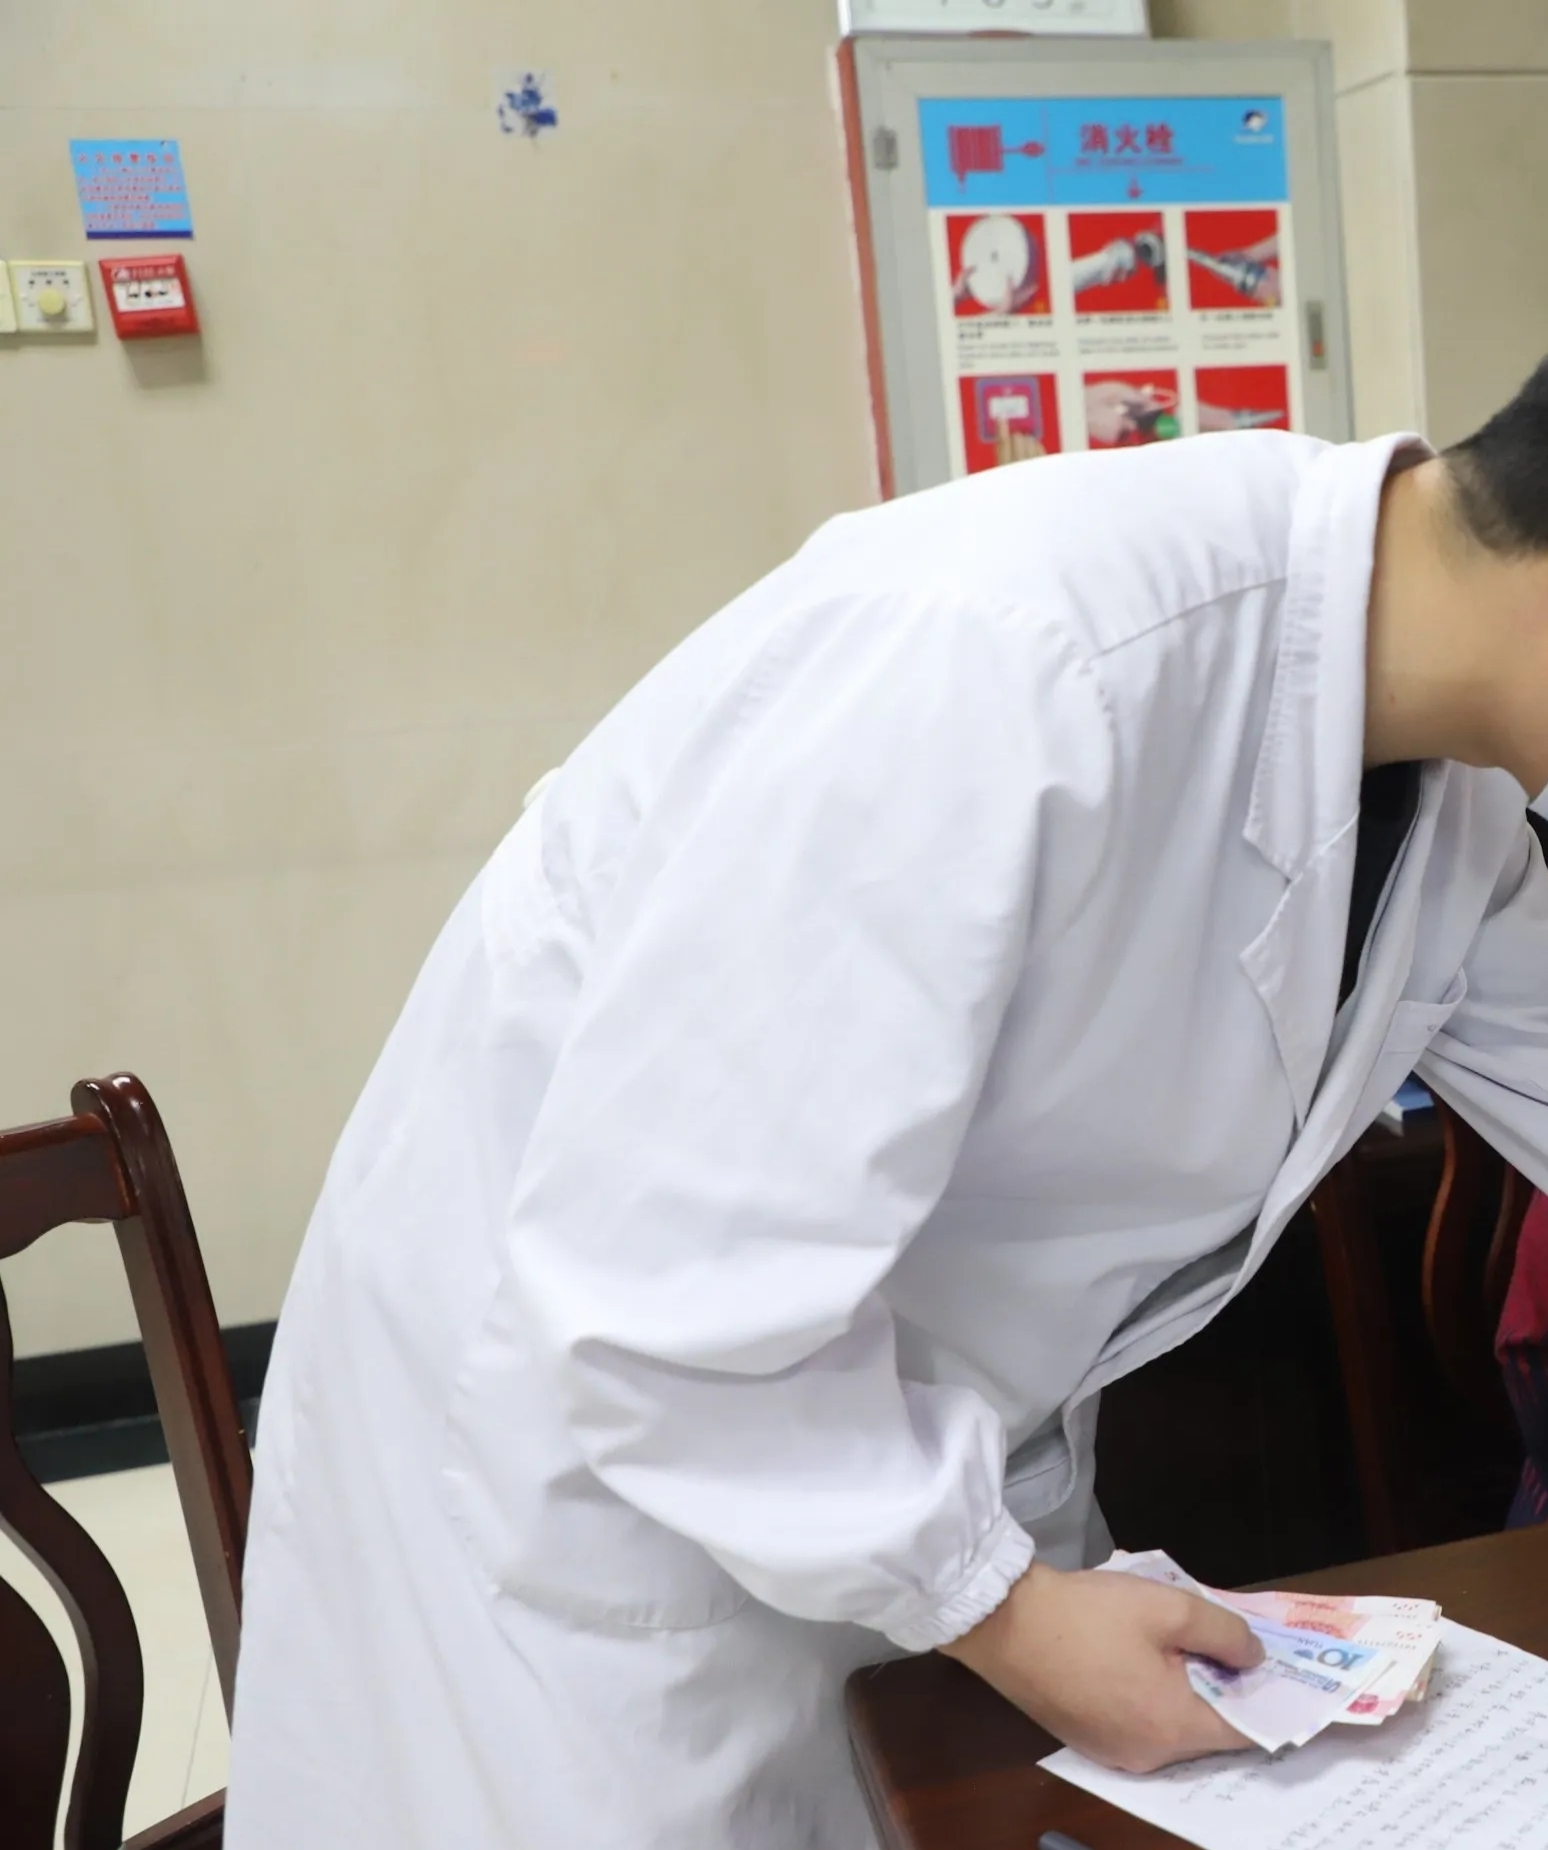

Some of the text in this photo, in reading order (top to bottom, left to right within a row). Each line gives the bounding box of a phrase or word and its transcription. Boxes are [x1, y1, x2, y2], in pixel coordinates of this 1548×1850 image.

[1080, 122, 1174, 154] 消火栓
[1317, 1649, 1364, 1671] 10
